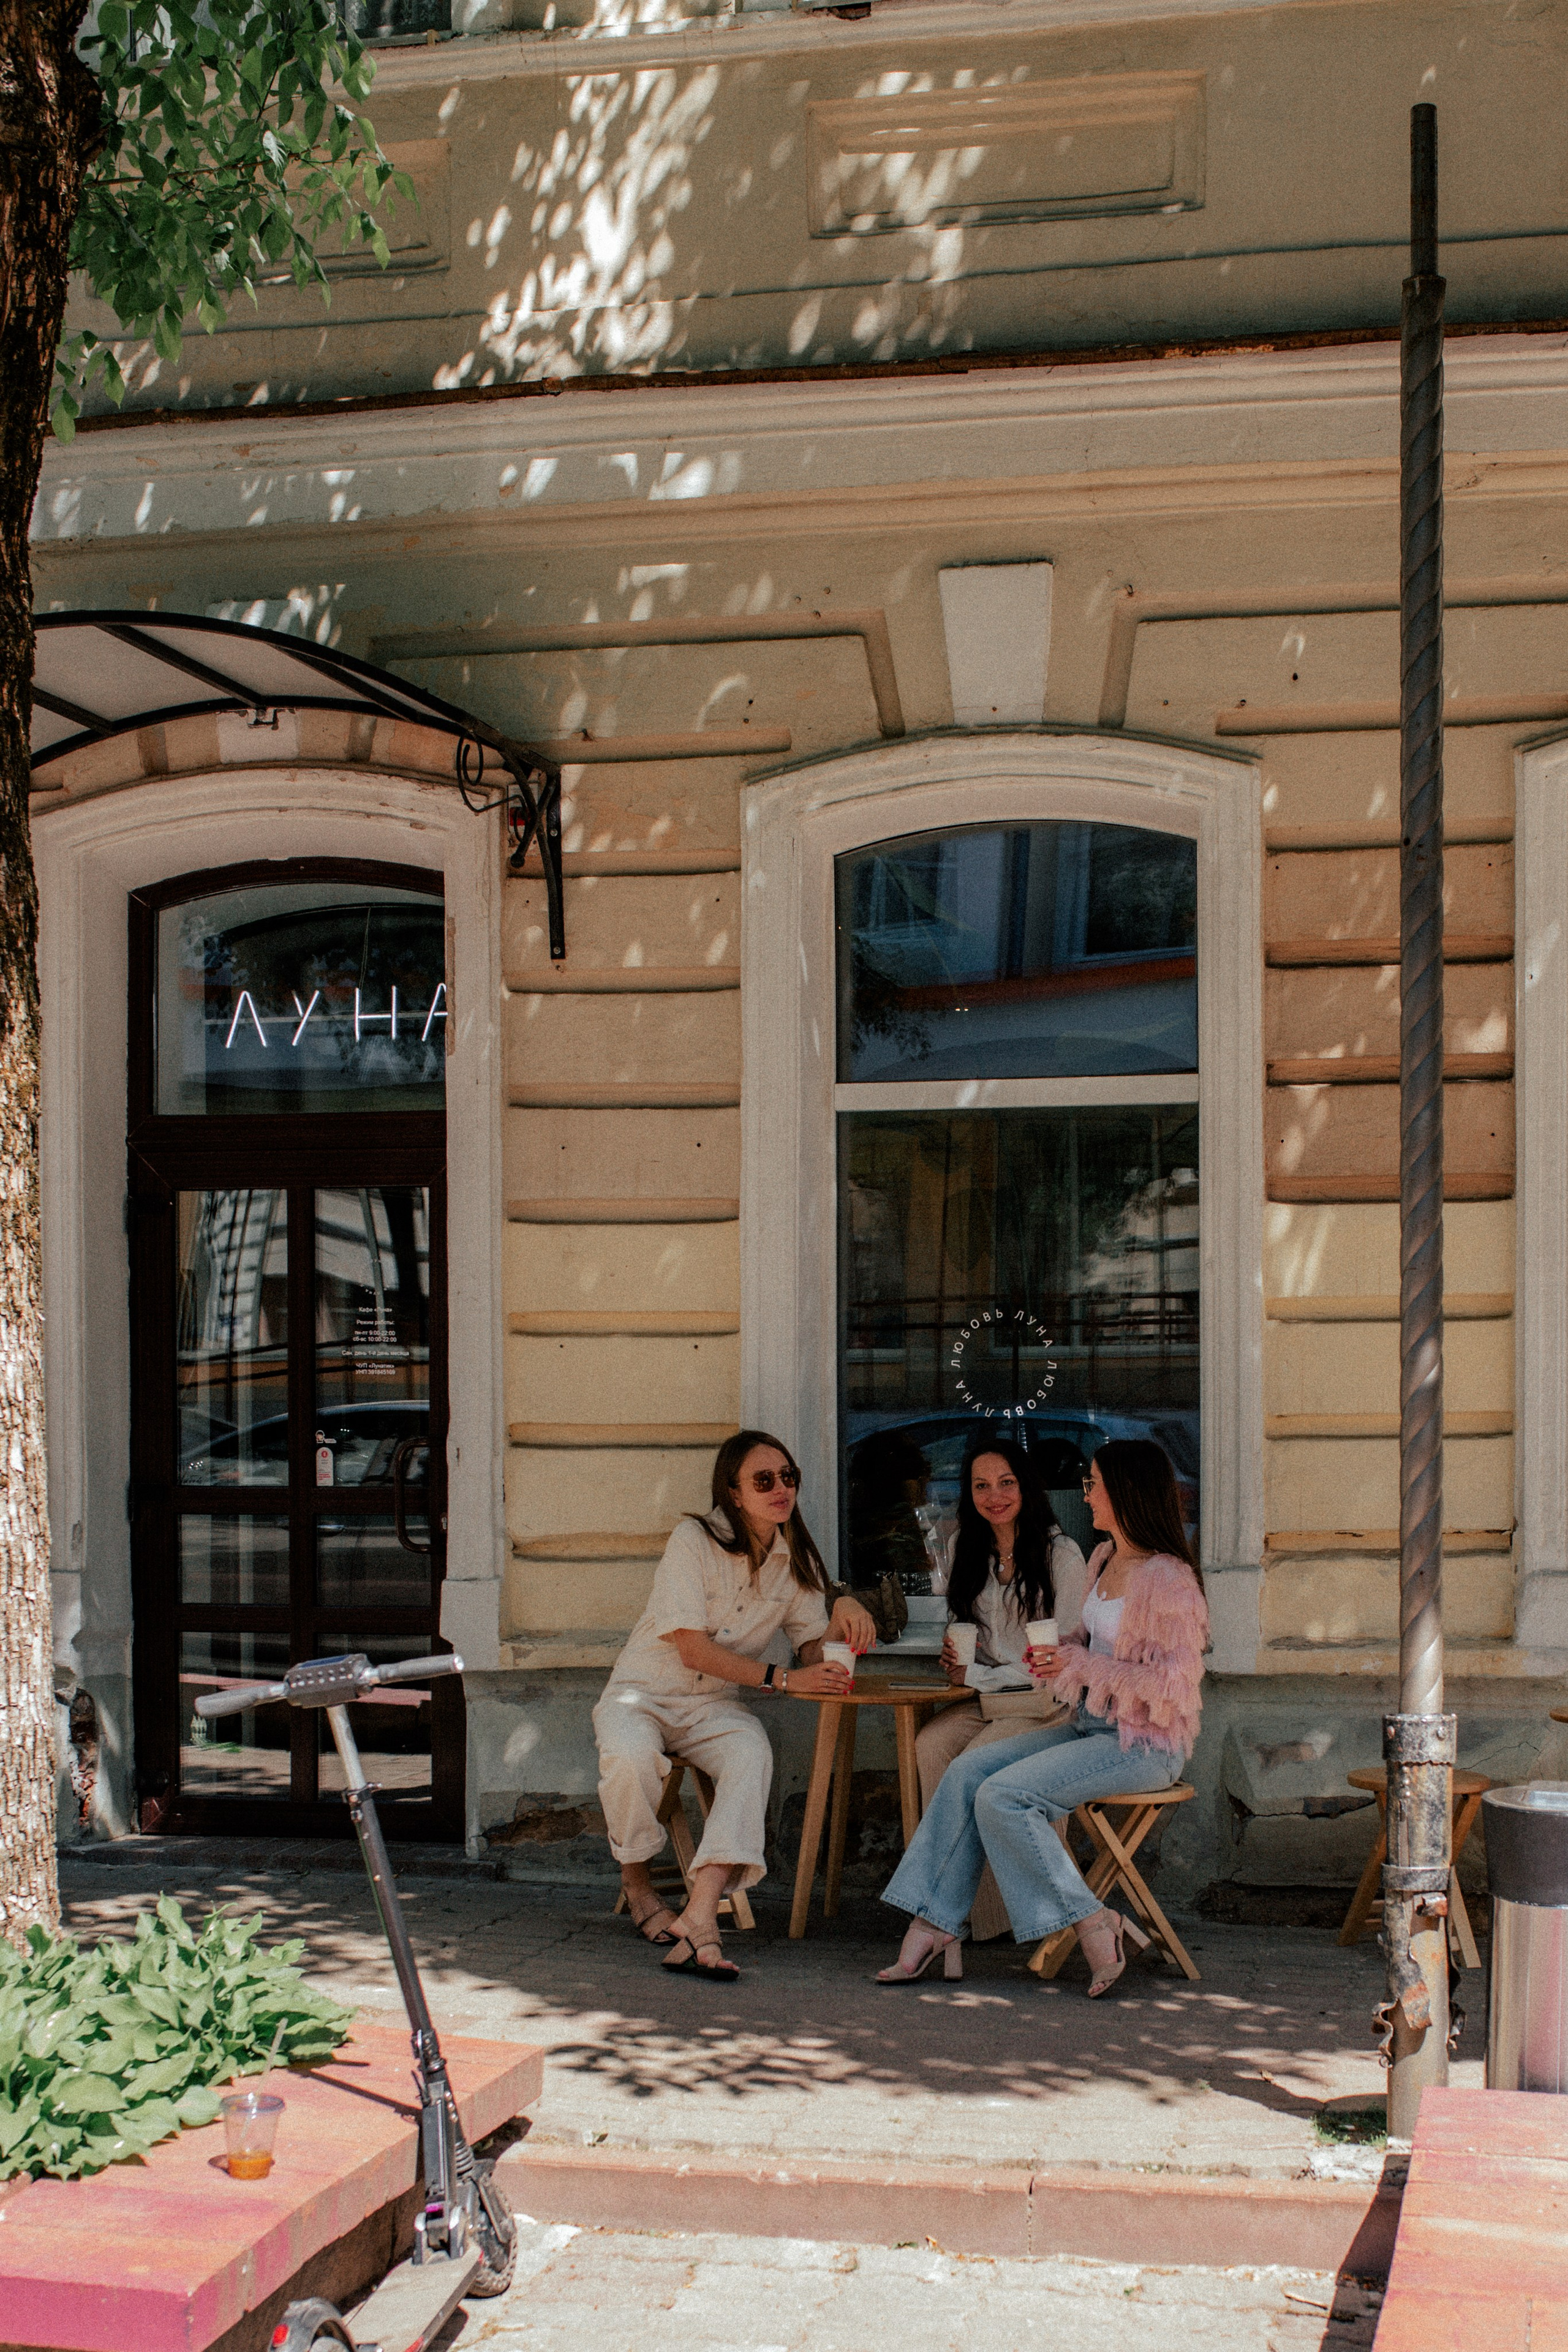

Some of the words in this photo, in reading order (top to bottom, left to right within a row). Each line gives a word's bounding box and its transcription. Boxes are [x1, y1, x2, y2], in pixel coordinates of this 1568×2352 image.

[951, 1309, 1003, 1368] ЛЮБОВЬ
[1014, 1310, 1053, 1348] ЛУНА
[956, 1380, 995, 1417] ЛУНА
[1003, 1361, 1057, 1419] ЛЮБОВЬ
